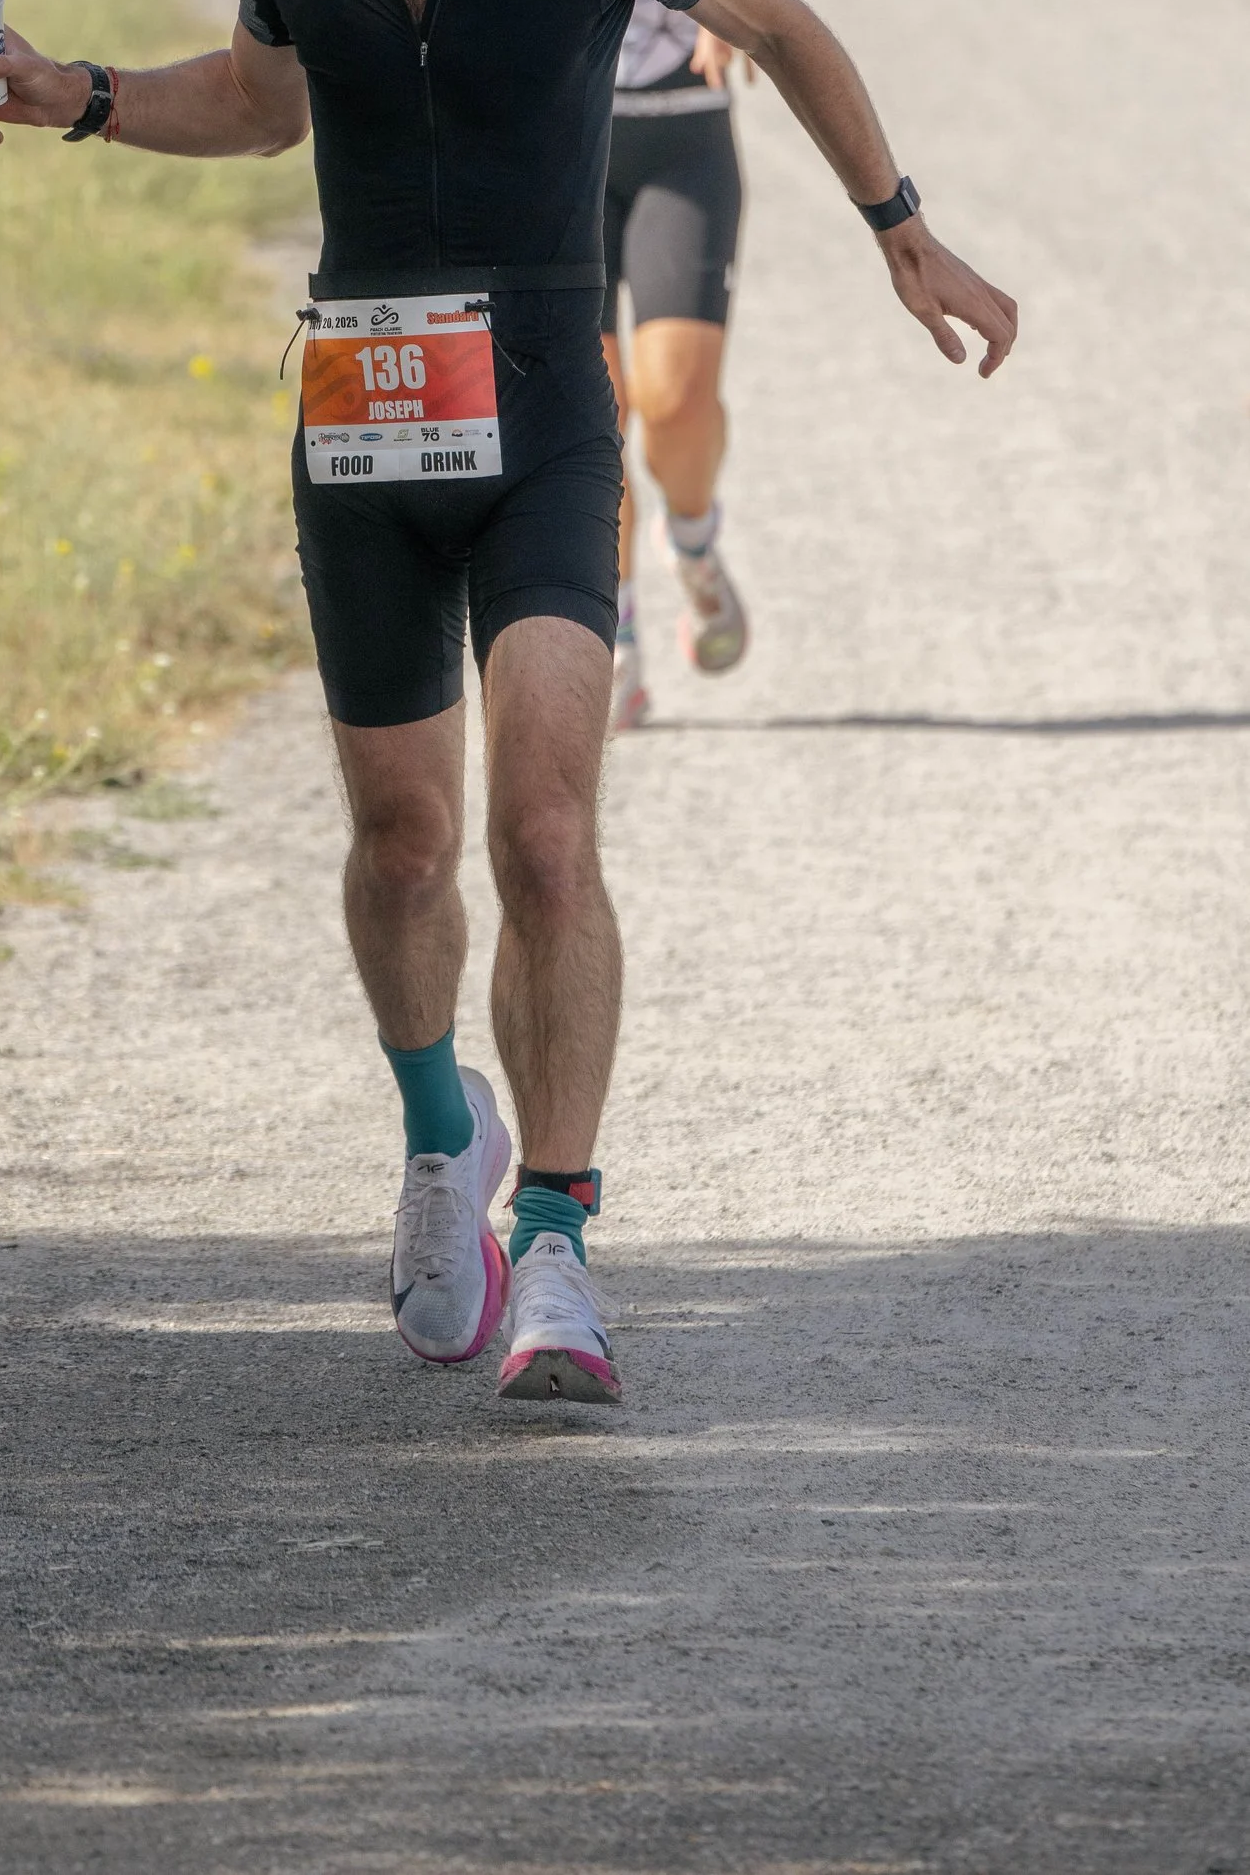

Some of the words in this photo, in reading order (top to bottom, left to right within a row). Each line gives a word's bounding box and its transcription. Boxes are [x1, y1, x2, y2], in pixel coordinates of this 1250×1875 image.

[322, 317, 334, 329] 20,
[335, 316, 358, 328] 2025
[427, 310, 479, 324] Standard
[355, 344, 426, 391] 136
[368, 399, 424, 420] JOSEPH
[422, 432, 440, 441] 70
[331, 455, 373, 476] FOOD
[421, 451, 478, 472] DRINK
